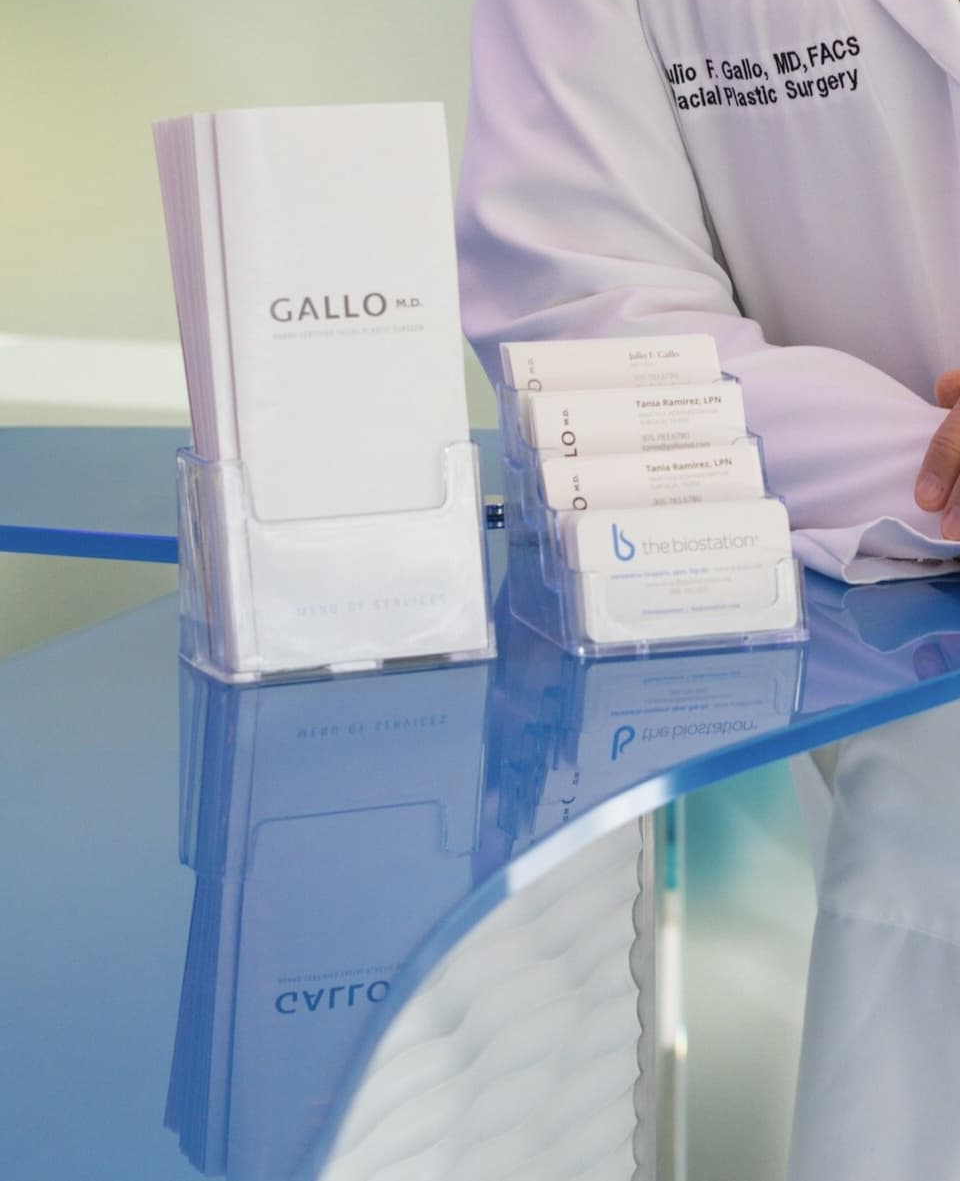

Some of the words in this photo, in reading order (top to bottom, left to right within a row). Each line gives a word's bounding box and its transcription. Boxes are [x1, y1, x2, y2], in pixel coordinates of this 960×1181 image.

[665, 62, 697, 85] ulio
[705, 58, 719, 79] F.
[721, 57, 769, 81] Gallo,
[671, 84, 722, 111] acial
[723, 84, 778, 108] Plastic
[784, 68, 859, 100] Surgery
[269, 292, 388, 323] GALLO
[396, 297, 423, 309] M.D.
[635, 399, 661, 409] Tania
[703, 395, 722, 405] LPN
[641, 538, 670, 556] the
